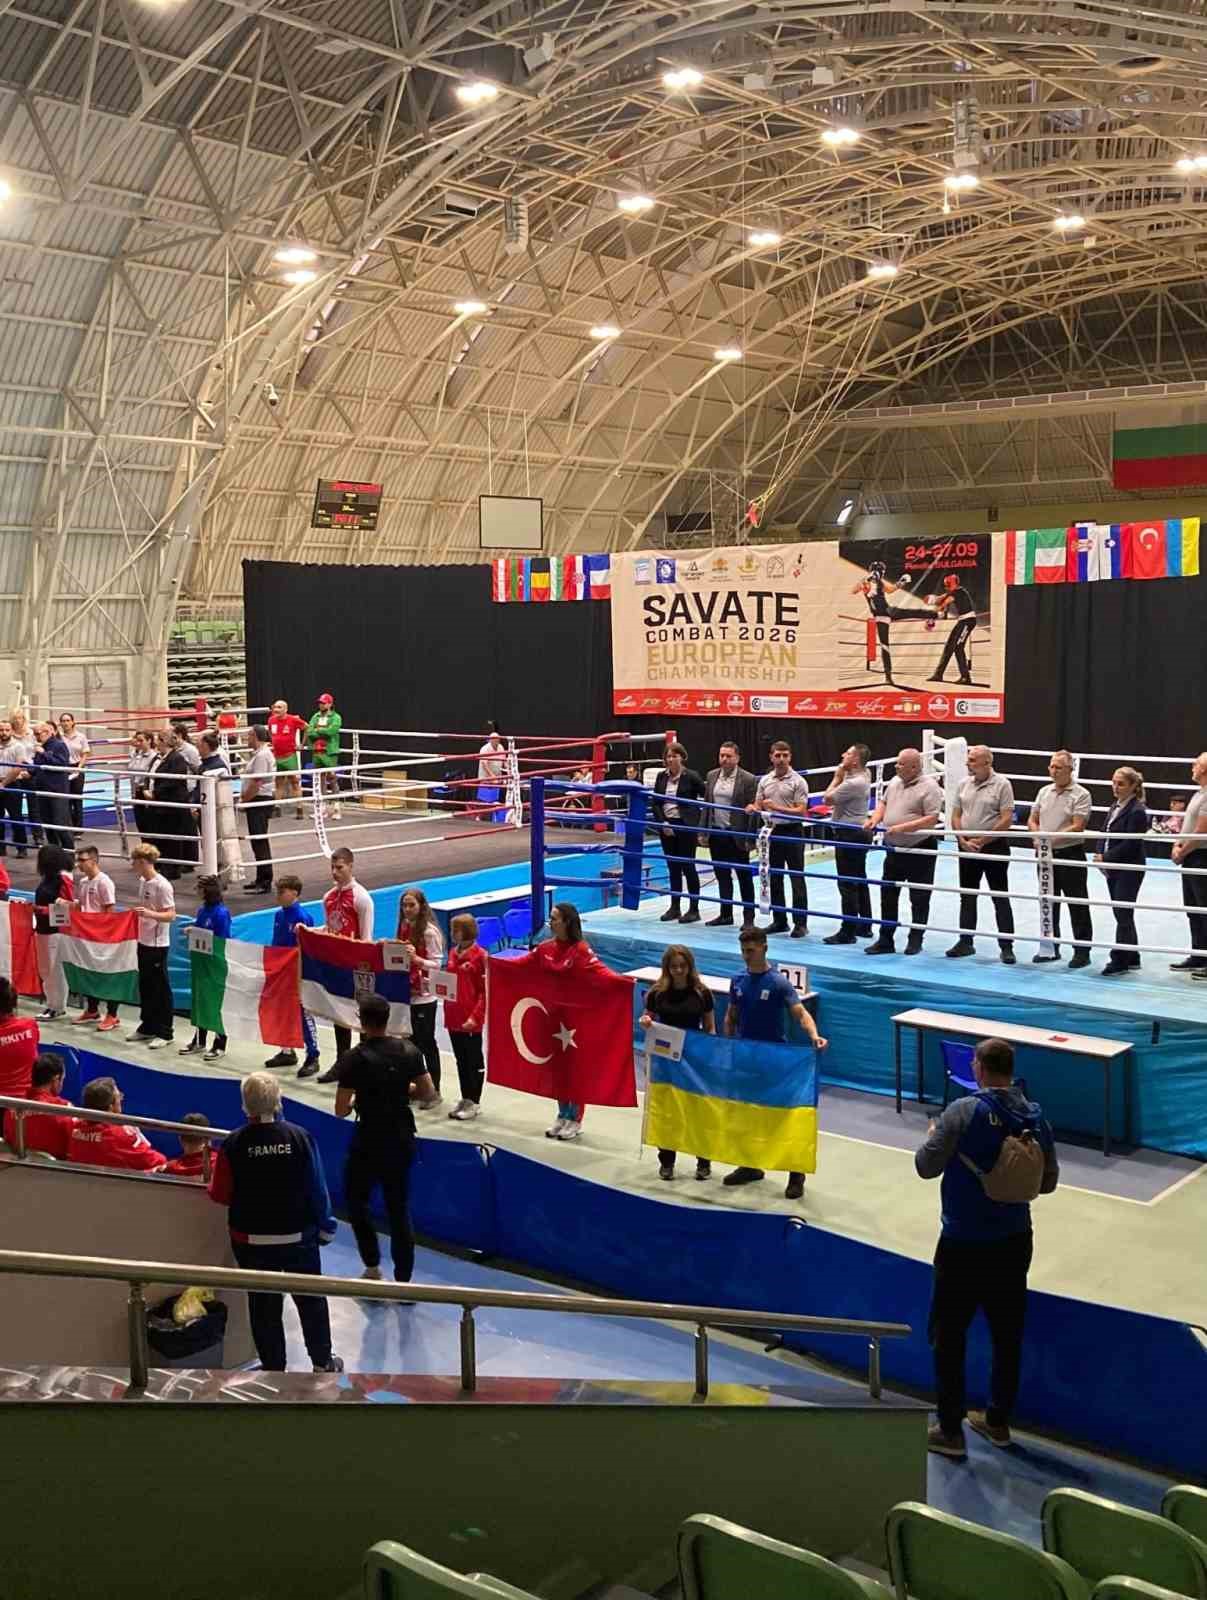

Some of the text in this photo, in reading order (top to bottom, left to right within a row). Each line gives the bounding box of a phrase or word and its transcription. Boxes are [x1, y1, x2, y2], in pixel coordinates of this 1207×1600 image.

[642, 590, 800, 627] SAVATE
[646, 626, 797, 643] COMBAT 2026
[647, 642, 797, 667] EUROPEAN
[647, 665, 796, 683] CHAMPIONSHIP
[247, 1143, 292, 1158] FRANCE
